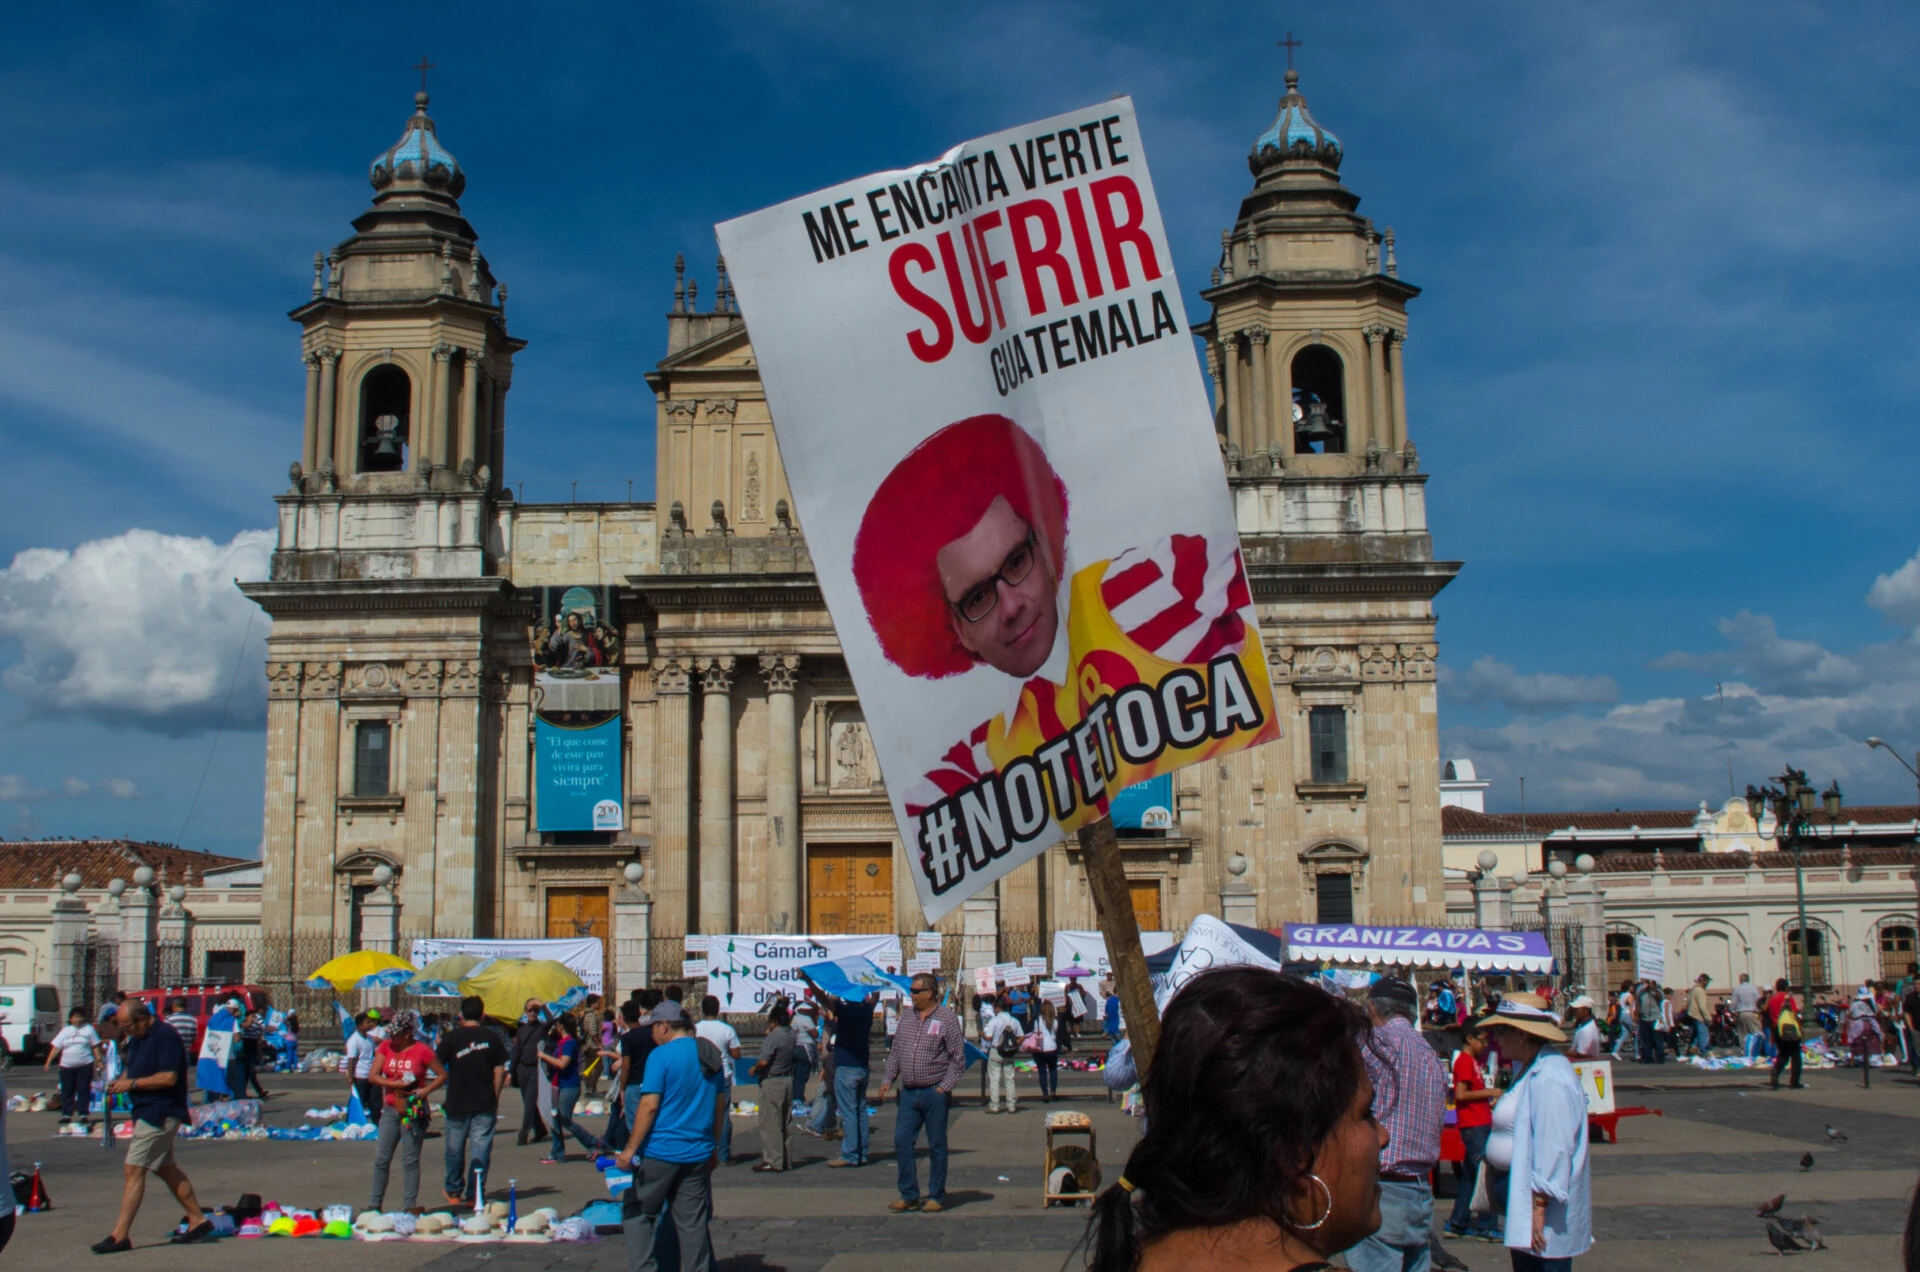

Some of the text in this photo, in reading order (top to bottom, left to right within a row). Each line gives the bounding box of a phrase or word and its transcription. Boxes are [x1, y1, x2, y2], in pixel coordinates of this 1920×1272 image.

[802, 115, 1129, 263] ME ENCANTA VERTE
[888, 175, 1162, 363] SUFRIR
[990, 290, 1177, 397] GUATEMALA
[563, 739, 580, 748] que
[551, 750, 563, 759] de
[586, 752, 604, 761] pan
[582, 764, 603, 774] para
[920, 654, 1263, 894] #NOTETOCA
[597, 805, 619, 817] 200
[1146, 811, 1168, 825] 200
[1293, 927, 1526, 951] GRANIZADAS
[754, 942, 827, 958] Cámara
[754, 965, 799, 981] Guat
